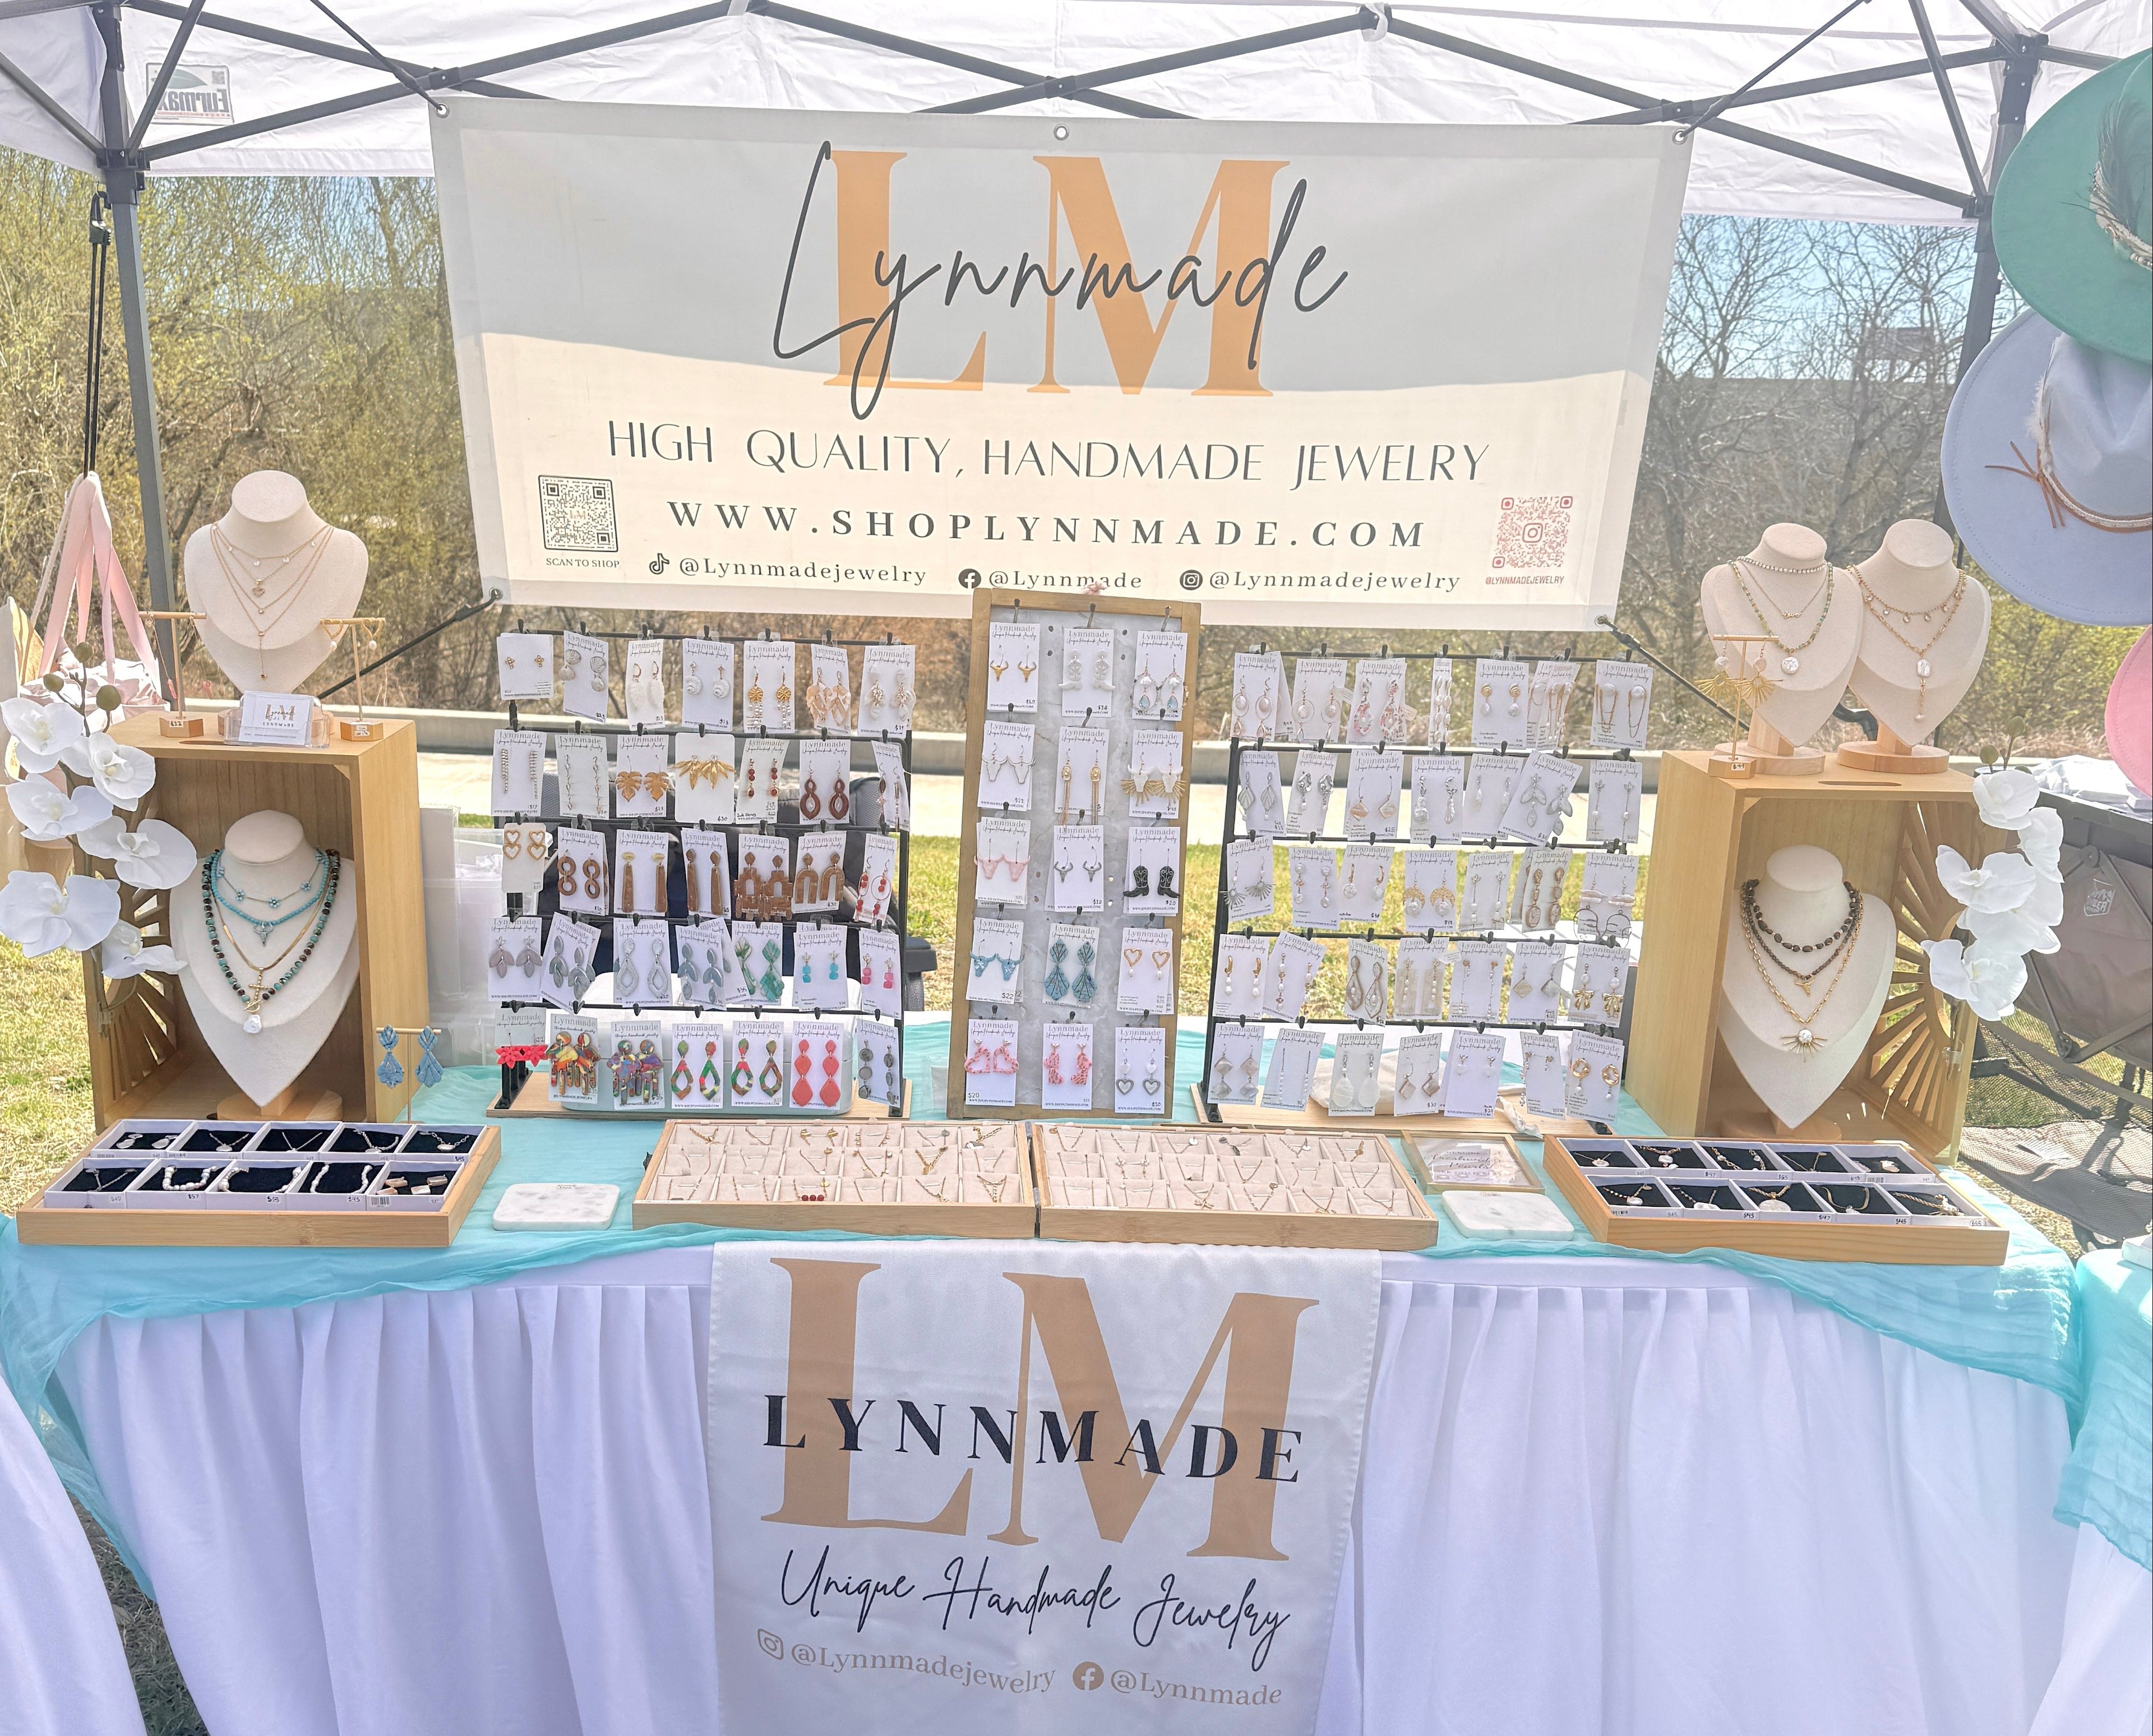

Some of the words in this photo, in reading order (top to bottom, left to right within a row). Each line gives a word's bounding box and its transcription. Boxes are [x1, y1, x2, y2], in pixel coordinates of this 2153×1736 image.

[774, 141, 1348, 419] Lynnmade
[608, 420, 713, 463] HIGH
[746, 429, 965, 478] QUALITY,
[983, 439, 1264, 481] HANDMADE
[1290, 443, 1490, 491] JEWELRY
[667, 501, 1424, 548] WWW.SHOPLYNNMADE.COM
[546, 557, 573, 567] SCAN
[575, 558, 589, 568] TO
[592, 559, 620, 569] SHOP
[680, 557, 927, 587] @Lynnmadejewelry
[1209, 570, 1461, 592] @Lynnmadejewelry
[1485, 575, 1565, 586] @LYNNMADEJEWELRY
[995, 624, 1036, 632] Lynnmade
[748, 645, 789, 654] Lynnmade
[869, 648, 909, 658] Lynnmade
[1239, 654, 1276, 665] Lynnmade
[1301, 661, 1342, 669] Lynnmade
[1362, 661, 1402, 671] Lynnmade
[1482, 663, 1524, 672] Lynnmade
[1606, 664, 1648, 674] Lynnmade
[990, 722, 1031, 733] Lynnmade
[500, 731, 541, 740] Lynnmade
[1064, 729, 1105, 738] Lynnmade
[1137, 732, 1178, 741] Lynnmade
[805, 740, 846, 749] Lynnmade
[1357, 757, 1398, 766] Lynnmade
[1595, 760, 1637, 769] Lynnmade
[986, 818, 1026, 829] Lynnmade
[561, 829, 599, 840] Lynnmade
[621, 832, 664, 841] Lynnmade
[1135, 828, 1175, 837] Lynnmade
[683, 833, 720, 843] Lynnmade
[744, 836, 785, 846] Lynnmade
[802, 836, 842, 846] Lynnmade
[1590, 854, 1634, 864] Lynnmade
[980, 918, 1019, 930] Lynnmade
[560, 921, 589, 940] Lynnmade
[1055, 925, 1095, 936] Lynnmade
[1128, 930, 1168, 939] Lynnmade
[798, 932, 840, 941] Lynnmade
[862, 934, 895, 944] Lynnmade
[1283, 934, 1323, 952] Lynnmade
[554, 1017, 595, 1027] Lynnmade
[738, 1022, 779, 1031] Lynnmade
[798, 1022, 839, 1032] Lynnmade
[973, 1022, 1014, 1030] Lynnmade
[614, 1023, 658, 1032] Lynnmade
[676, 1024, 719, 1033] Lynnmade
[1048, 1025, 1088, 1033] Lynnmade
[1121, 1029, 1161, 1037] Lynnmade
[1459, 1036, 1501, 1045] Lynnmade
[1578, 1038, 1620, 1052] Lynnmade
[761, 1257, 1320, 1560] LM
[763, 1395, 1302, 1483] LYNNMADE
[781, 1545, 915, 1632] Unique
[922, 1556, 1120, 1635] Handmade
[1134, 1573, 1291, 1672] Jewelry
[792, 1643, 1056, 1694] @Lynnmadejewelry
[1110, 1670, 1282, 1706] @Lynnmade
